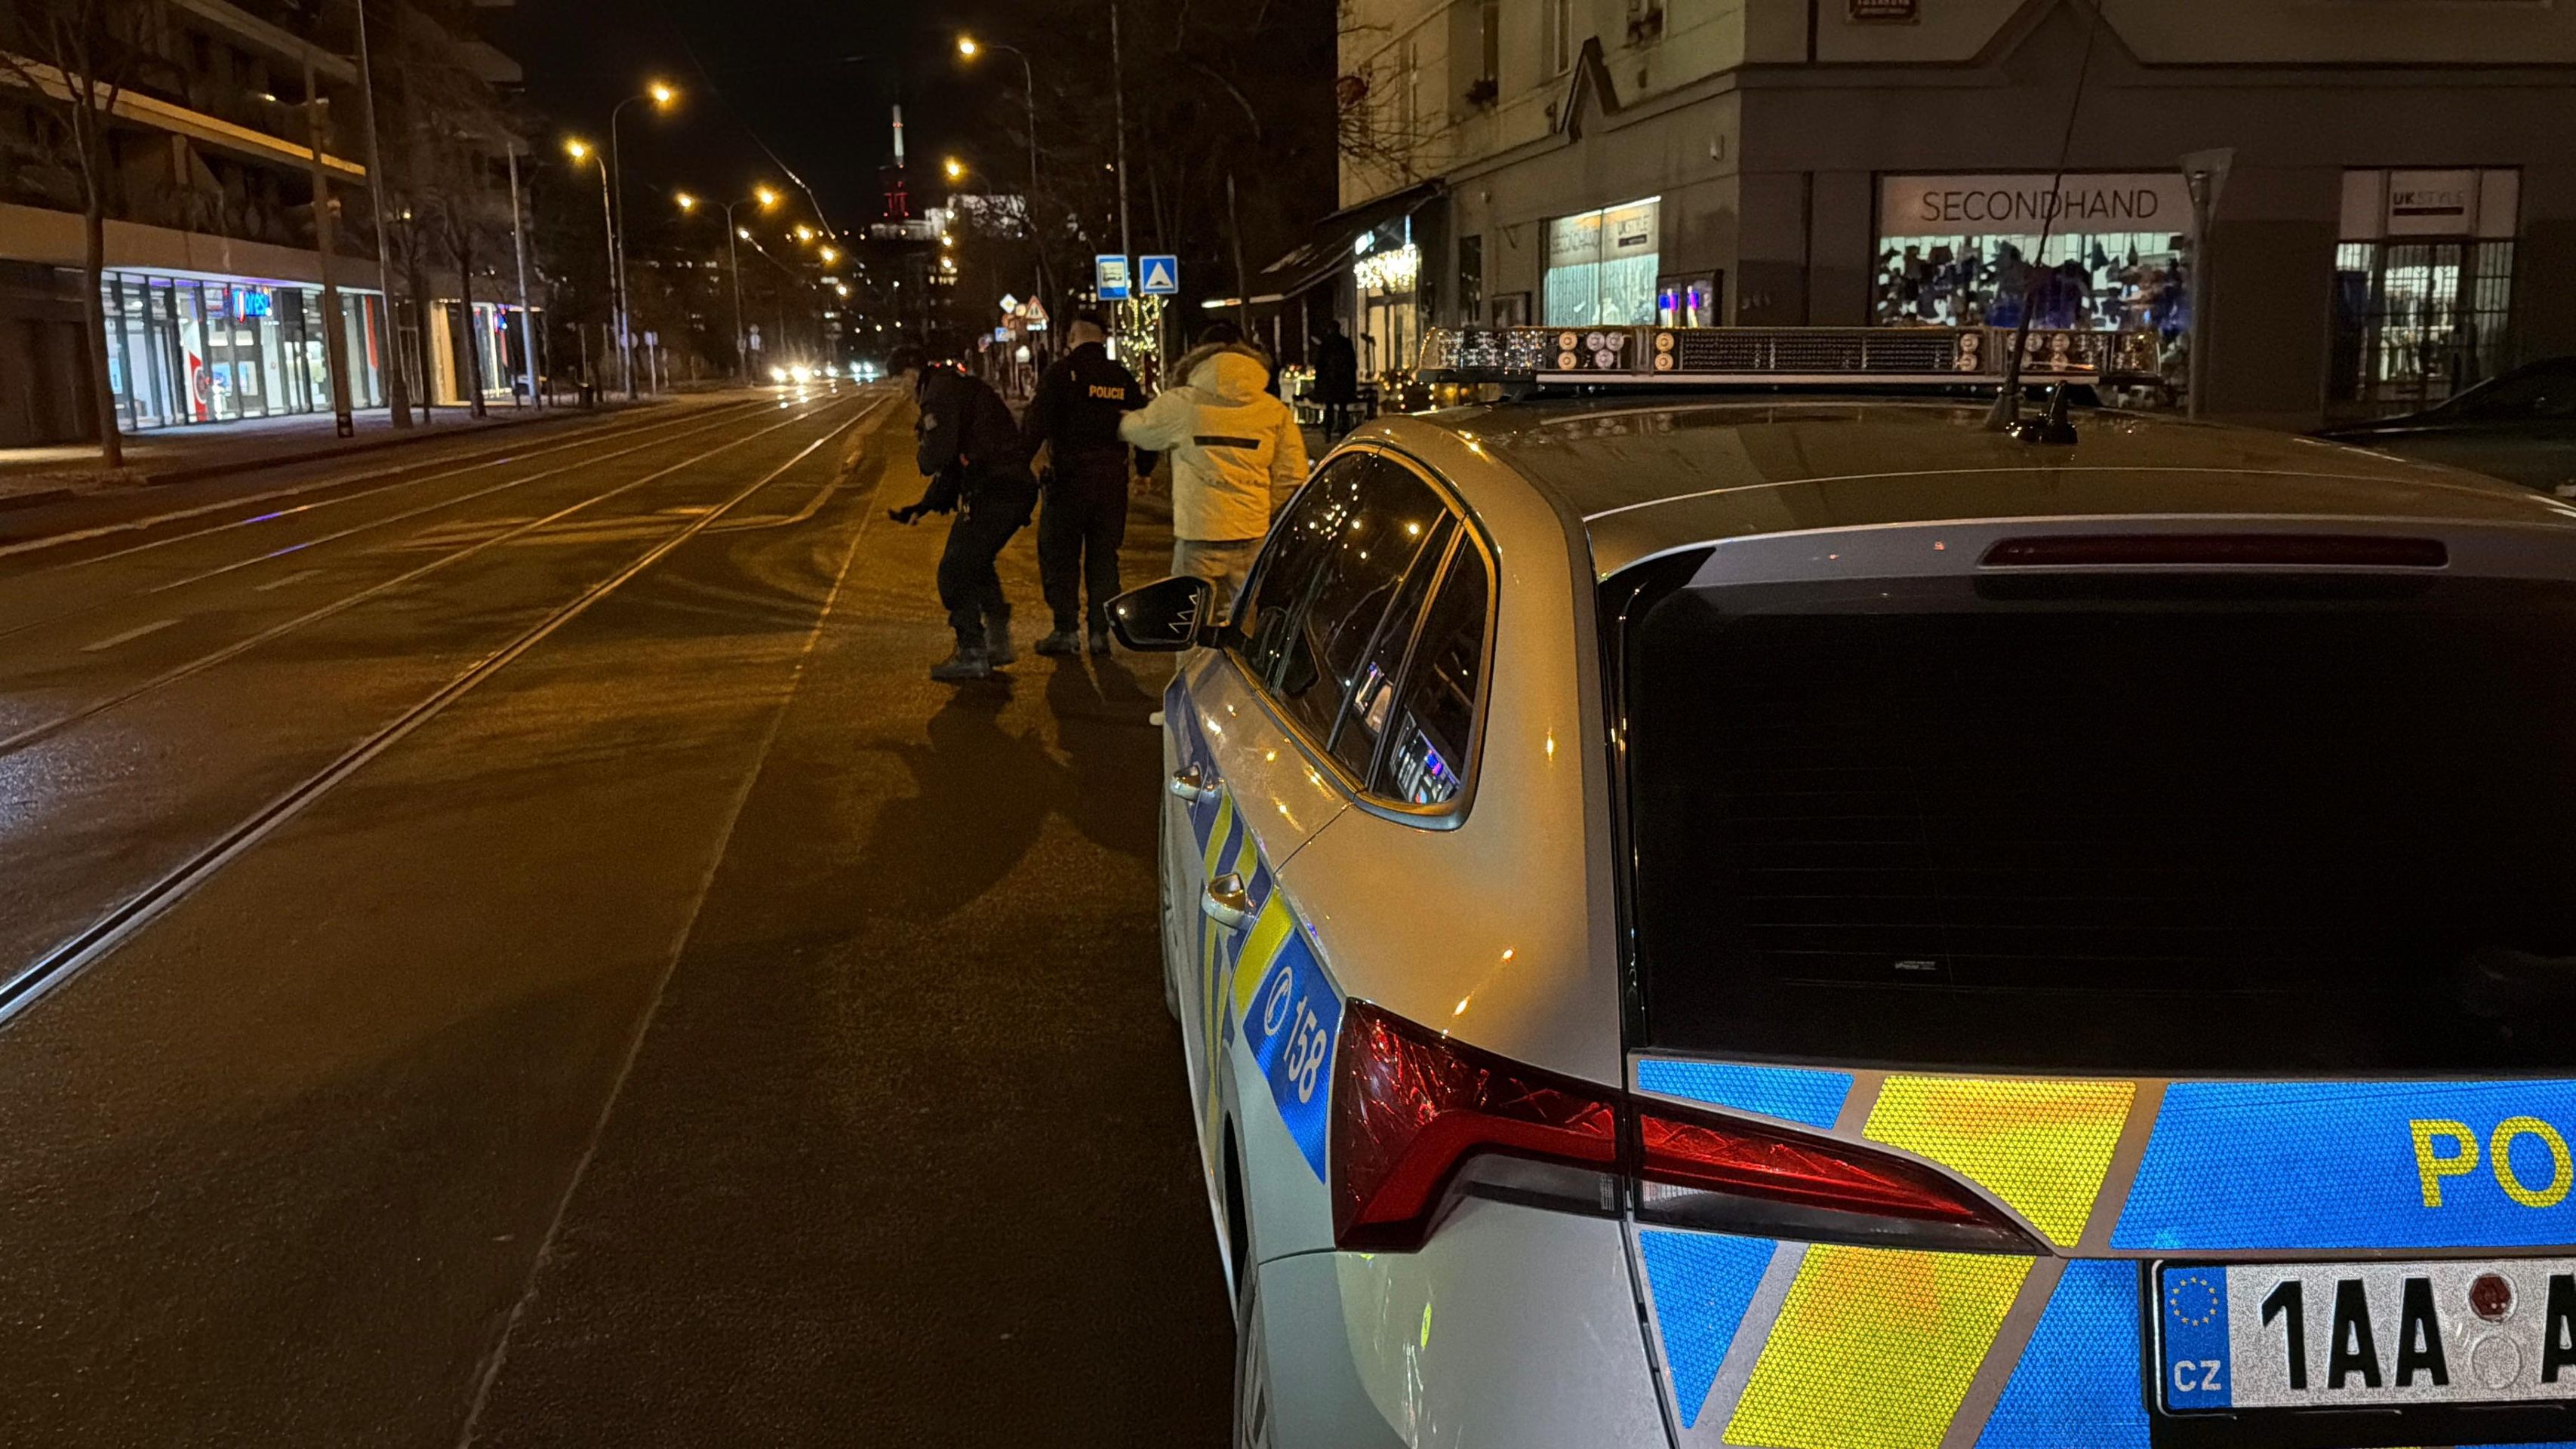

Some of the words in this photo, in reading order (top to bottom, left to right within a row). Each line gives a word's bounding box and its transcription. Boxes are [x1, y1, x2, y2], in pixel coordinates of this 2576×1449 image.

[1920, 189, 2158, 222] SECONDHAND
[1089, 384, 1125, 400] POLICIE
[1283, 995, 1327, 1104] 158
[2409, 1115, 2574, 1208] PO
[2261, 1277, 2450, 1389] 1AA
[2173, 1360, 2223, 1392] CZ
